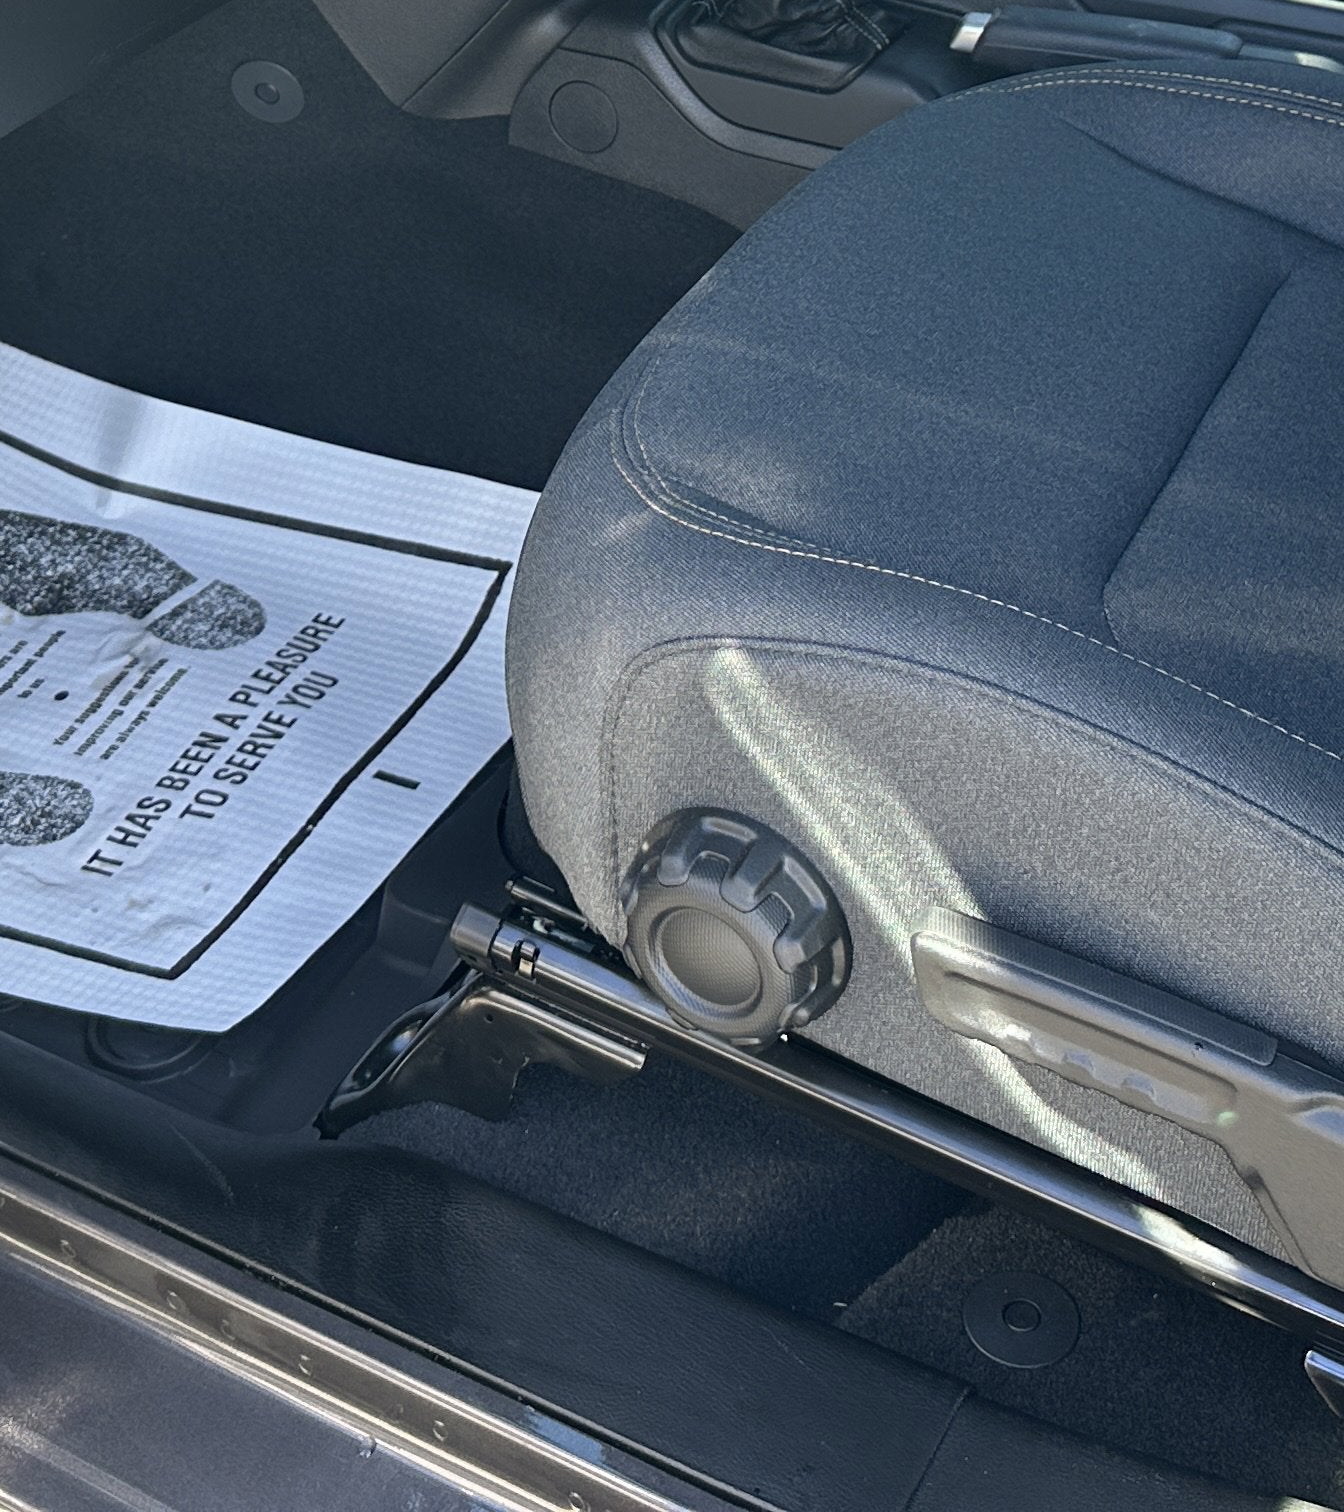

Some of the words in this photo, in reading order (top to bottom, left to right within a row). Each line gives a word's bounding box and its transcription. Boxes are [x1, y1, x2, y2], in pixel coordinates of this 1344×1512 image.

[228, 612, 346, 707] PLEASURE
[178, 788, 229, 819] TO
[213, 710, 298, 785] SERVE
[277, 671, 339, 708] YOU
[212, 712, 248, 730] A
[155, 731, 229, 791] BEEN
[106, 796, 173, 848] HAS
[81, 849, 124, 877] IT
